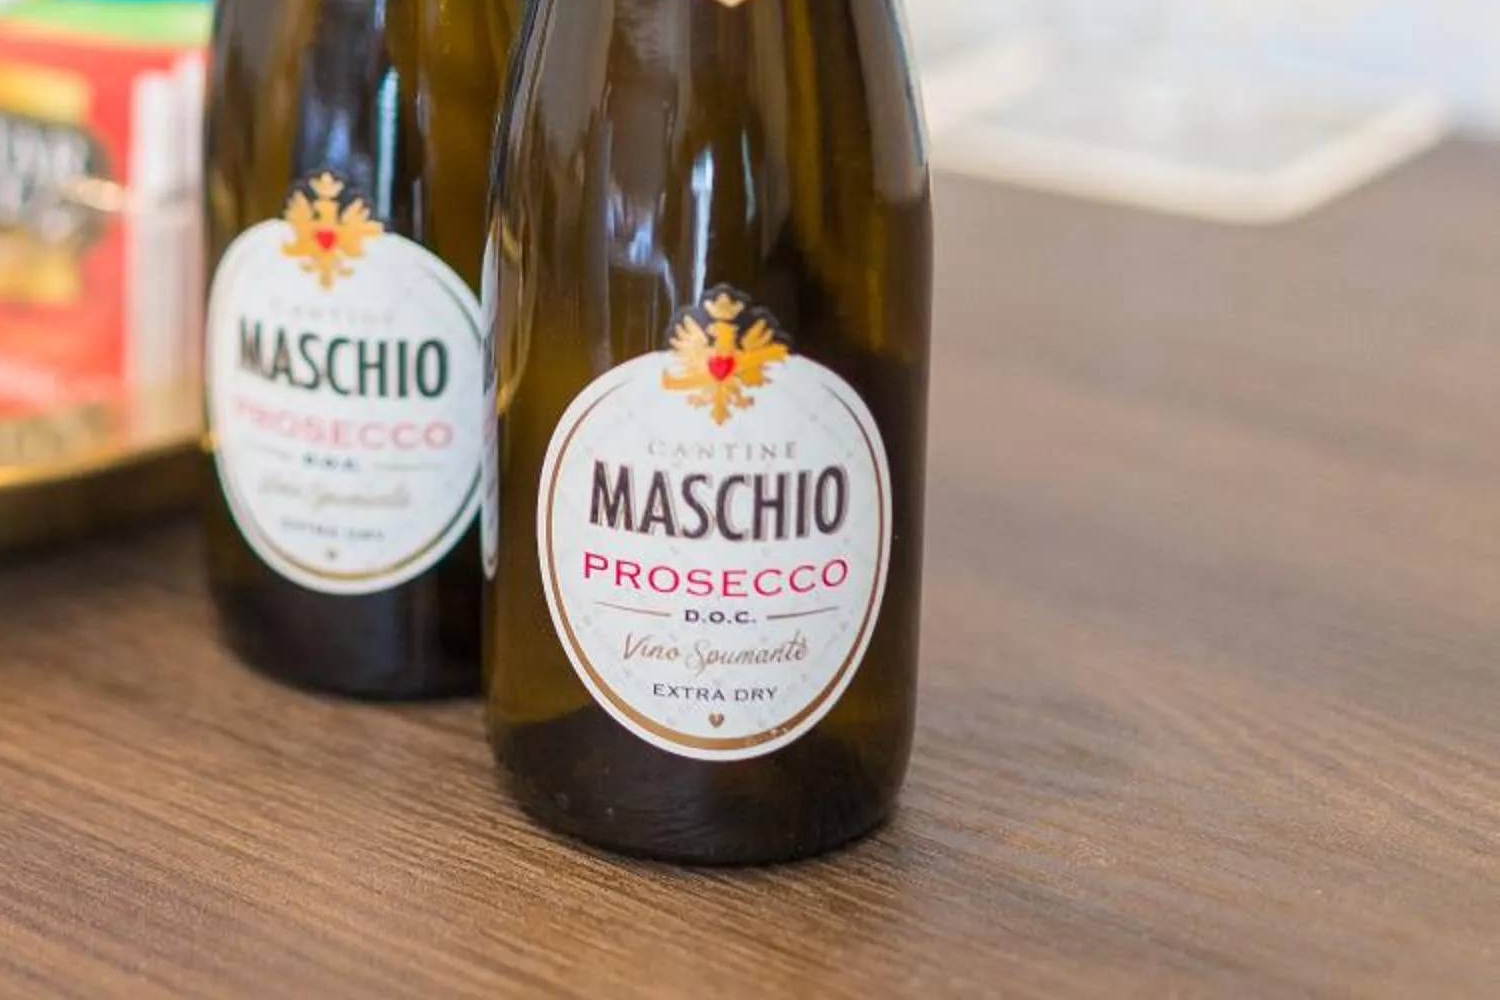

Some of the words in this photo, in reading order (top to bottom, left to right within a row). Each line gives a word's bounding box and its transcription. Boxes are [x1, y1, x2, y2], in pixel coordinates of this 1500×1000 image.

[239, 314, 449, 399] MASCHIO
[647, 438, 798, 461] CANTINE
[588, 460, 850, 541] MASCHIO
[583, 551, 850, 597] PROSECCO
[684, 609, 757, 624] D.O.C.
[622, 630, 680, 661] Vino
[684, 629, 809, 677] Spumante
[653, 683, 725, 701] EXTRA
[734, 686, 779, 701] DRY
